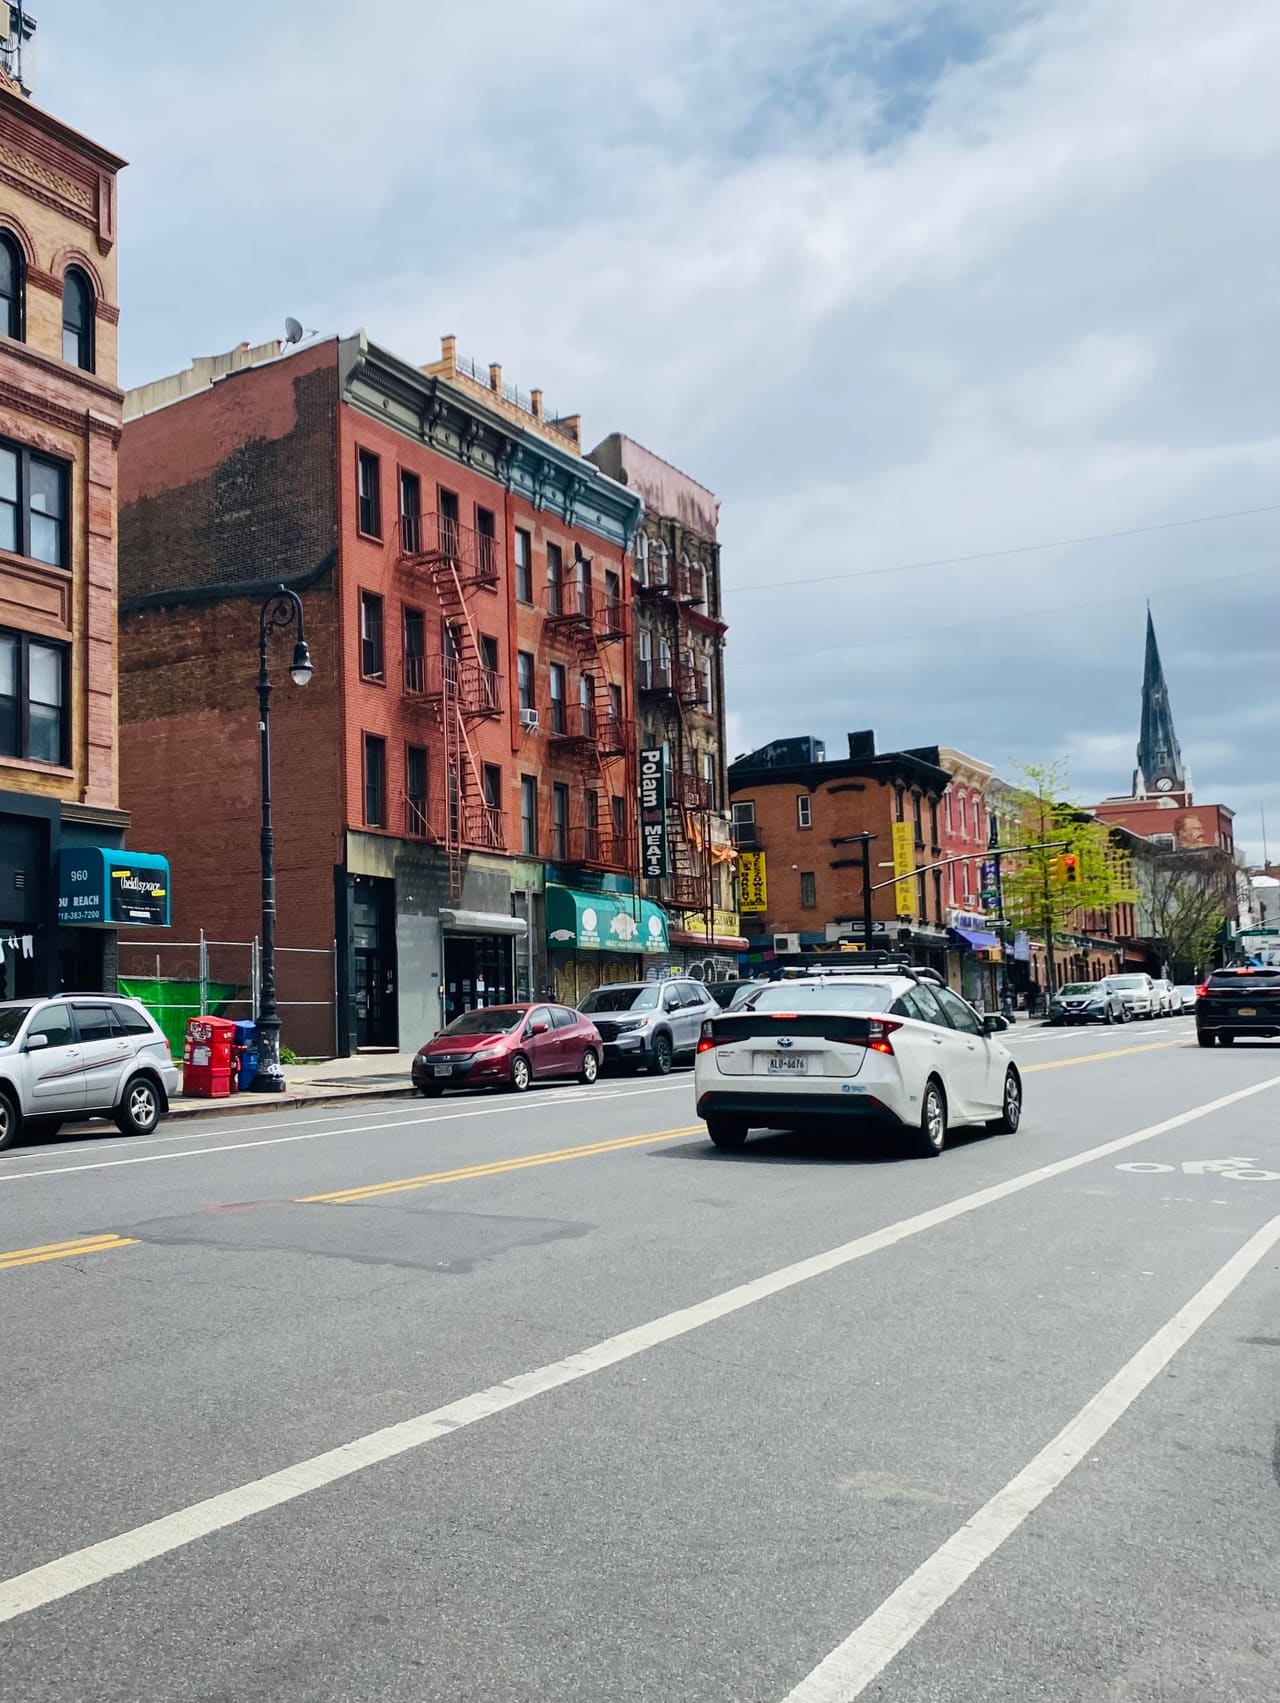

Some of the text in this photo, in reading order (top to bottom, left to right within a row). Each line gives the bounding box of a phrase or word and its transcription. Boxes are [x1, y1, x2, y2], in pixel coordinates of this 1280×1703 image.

[642, 751, 661, 806] Polam
[645, 825, 662, 875] MEATS
[71, 870, 88, 881] 960
[73, 895, 99, 906] REACH
